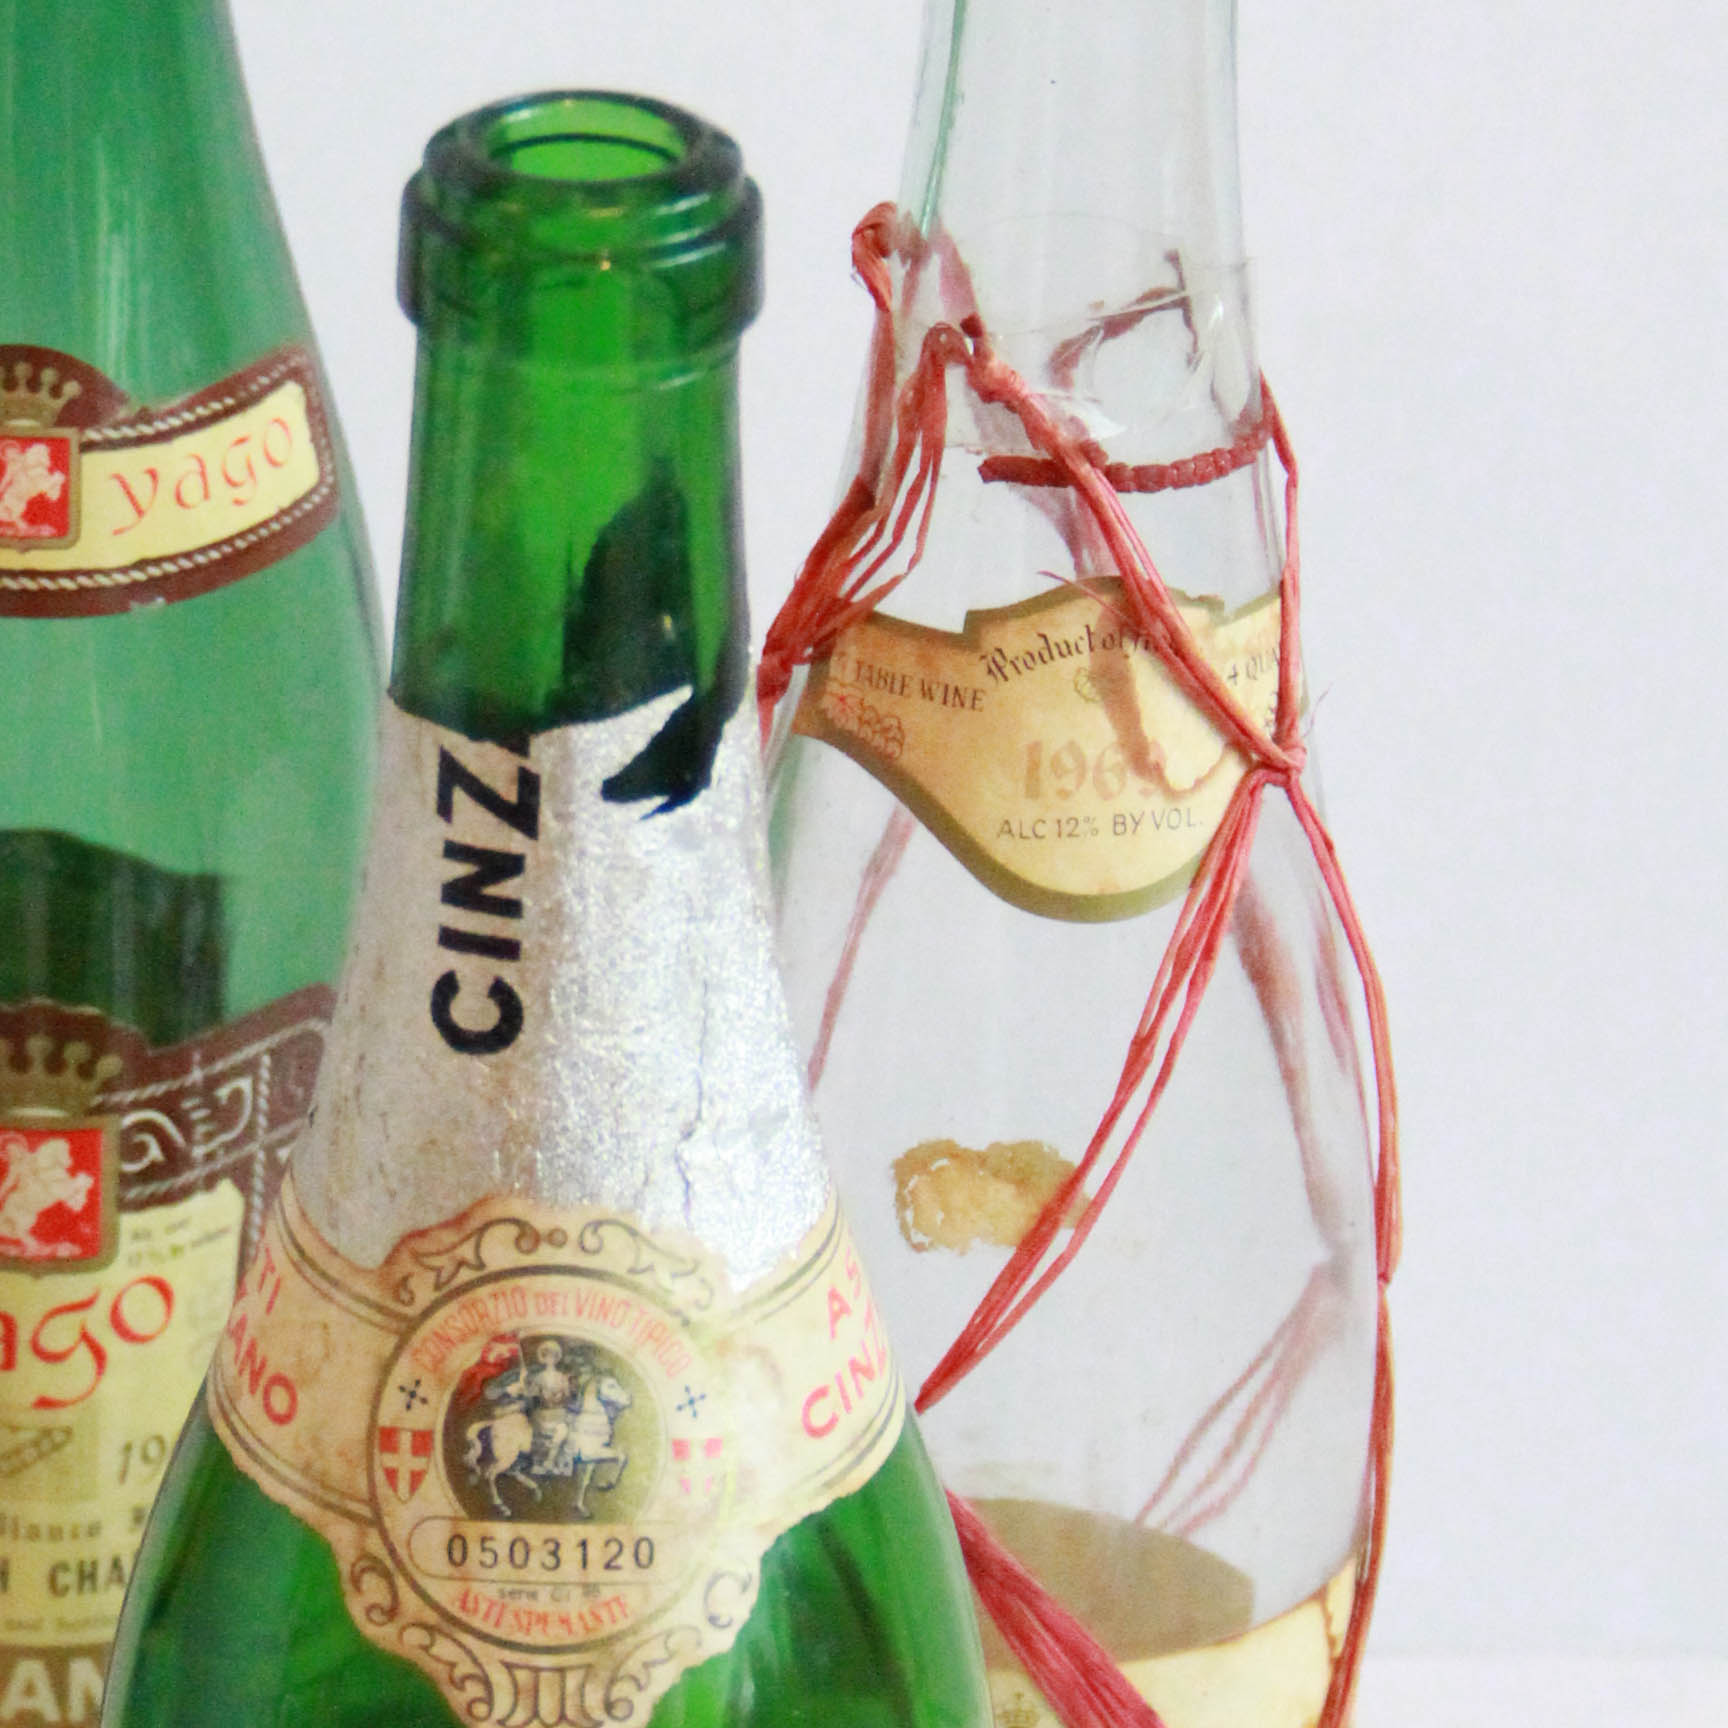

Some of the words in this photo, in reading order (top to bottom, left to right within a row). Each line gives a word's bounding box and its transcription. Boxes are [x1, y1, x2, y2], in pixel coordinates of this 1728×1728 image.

[110, 417, 293, 536] yago
[979, 624, 1094, 684] Product
[920, 677, 986, 712] WINE
[997, 818, 1047, 839] ALC
[1057, 815, 1100, 838] 12%
[1113, 810, 1145, 836] BY
[447, 1533, 655, 1571] 0503120
